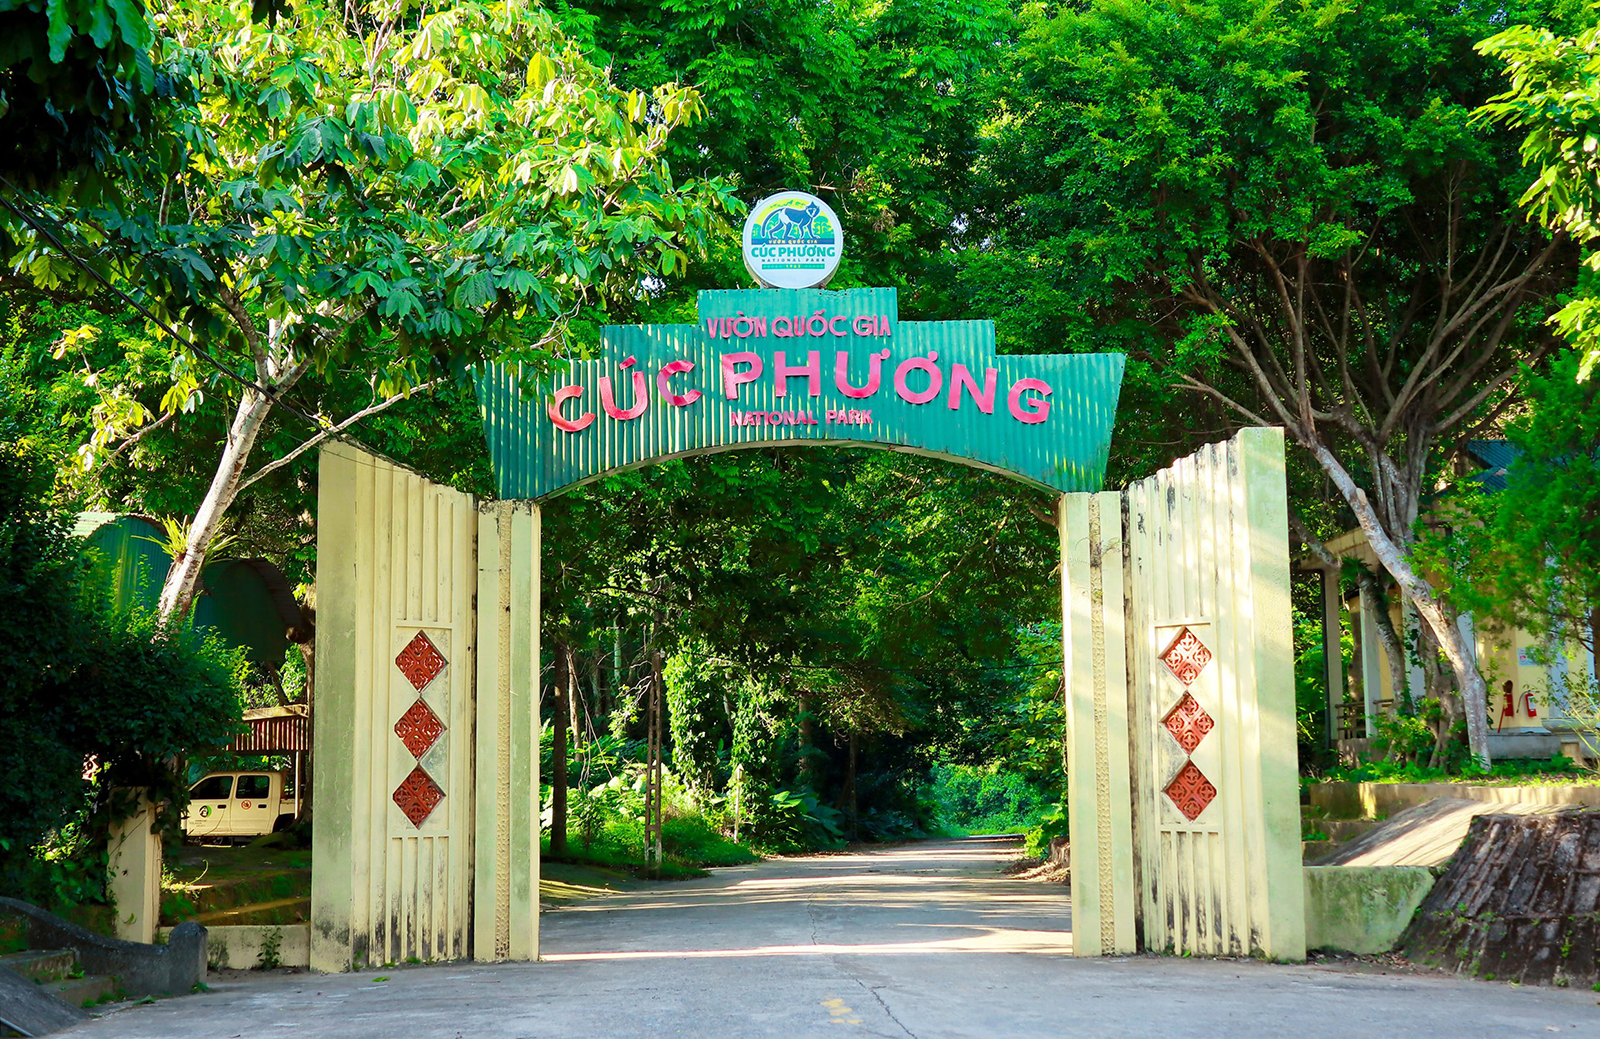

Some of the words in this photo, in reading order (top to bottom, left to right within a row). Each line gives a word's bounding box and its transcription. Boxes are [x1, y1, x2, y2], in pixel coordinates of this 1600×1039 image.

[751, 243, 776, 257] CÚC
[778, 245, 836, 257] PHƯƠNG
[706, 311, 767, 339] VƯỜN
[771, 309, 847, 338] QUỐC
[852, 315, 891, 337] GIA
[548, 355, 702, 432] CÚC
[721, 348, 1053, 424] PHƯƠNG
[730, 409, 818, 427] NATIONAL
[826, 409, 873, 426] PARK
